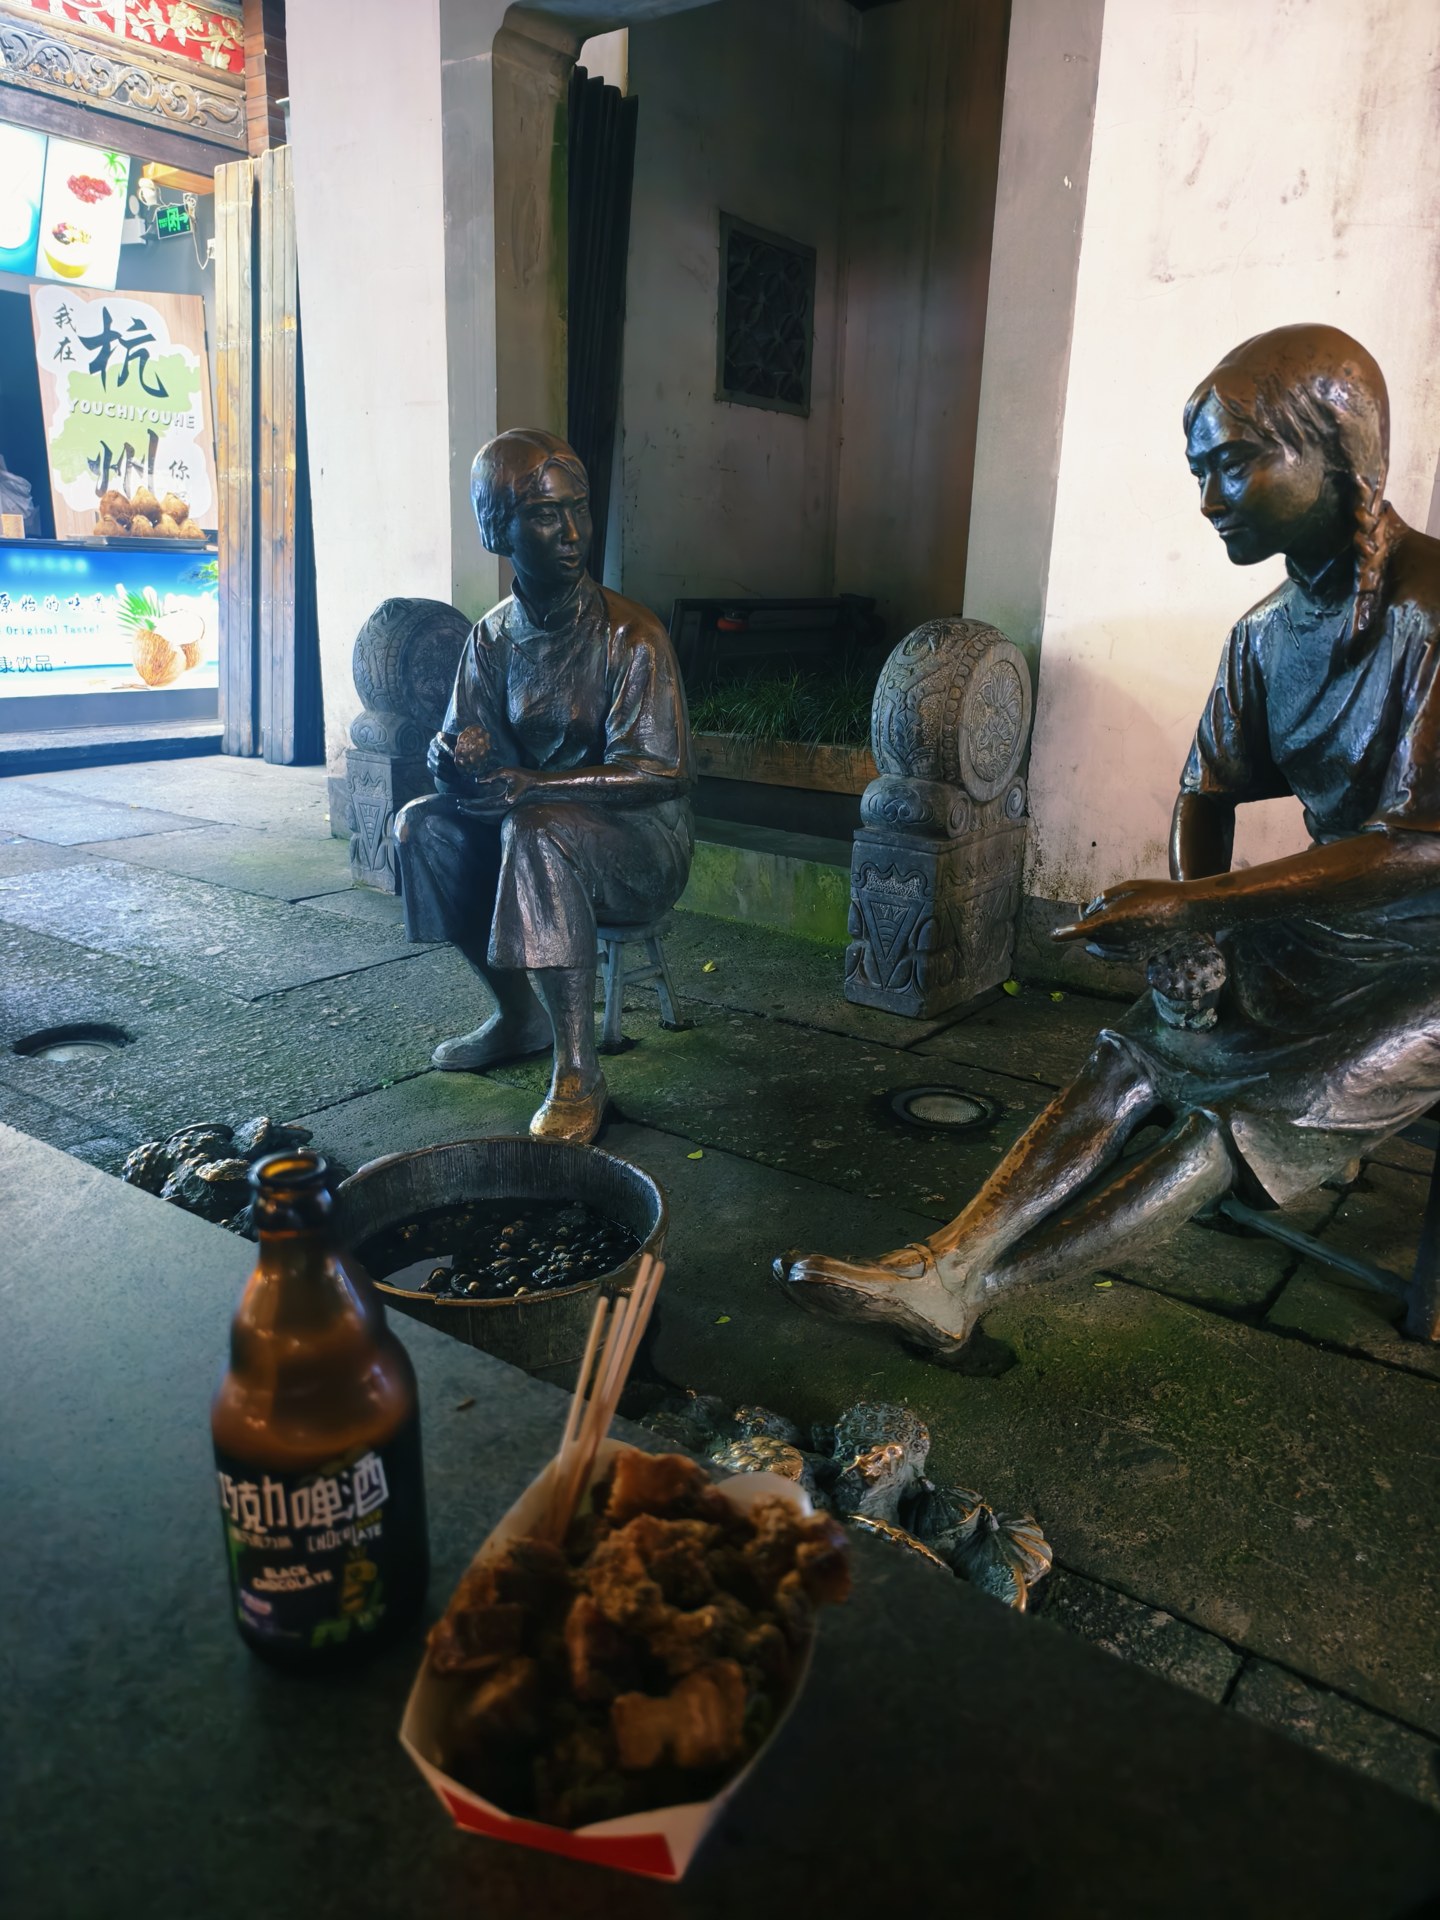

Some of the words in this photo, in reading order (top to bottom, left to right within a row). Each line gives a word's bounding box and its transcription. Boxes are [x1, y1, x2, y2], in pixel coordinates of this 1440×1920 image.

[53, 302, 76, 363] 我在
[79, 306, 169, 398] 杭
[69, 399, 195, 429] YOUCHIYOUHE
[6, 624, 58, 636] Original
